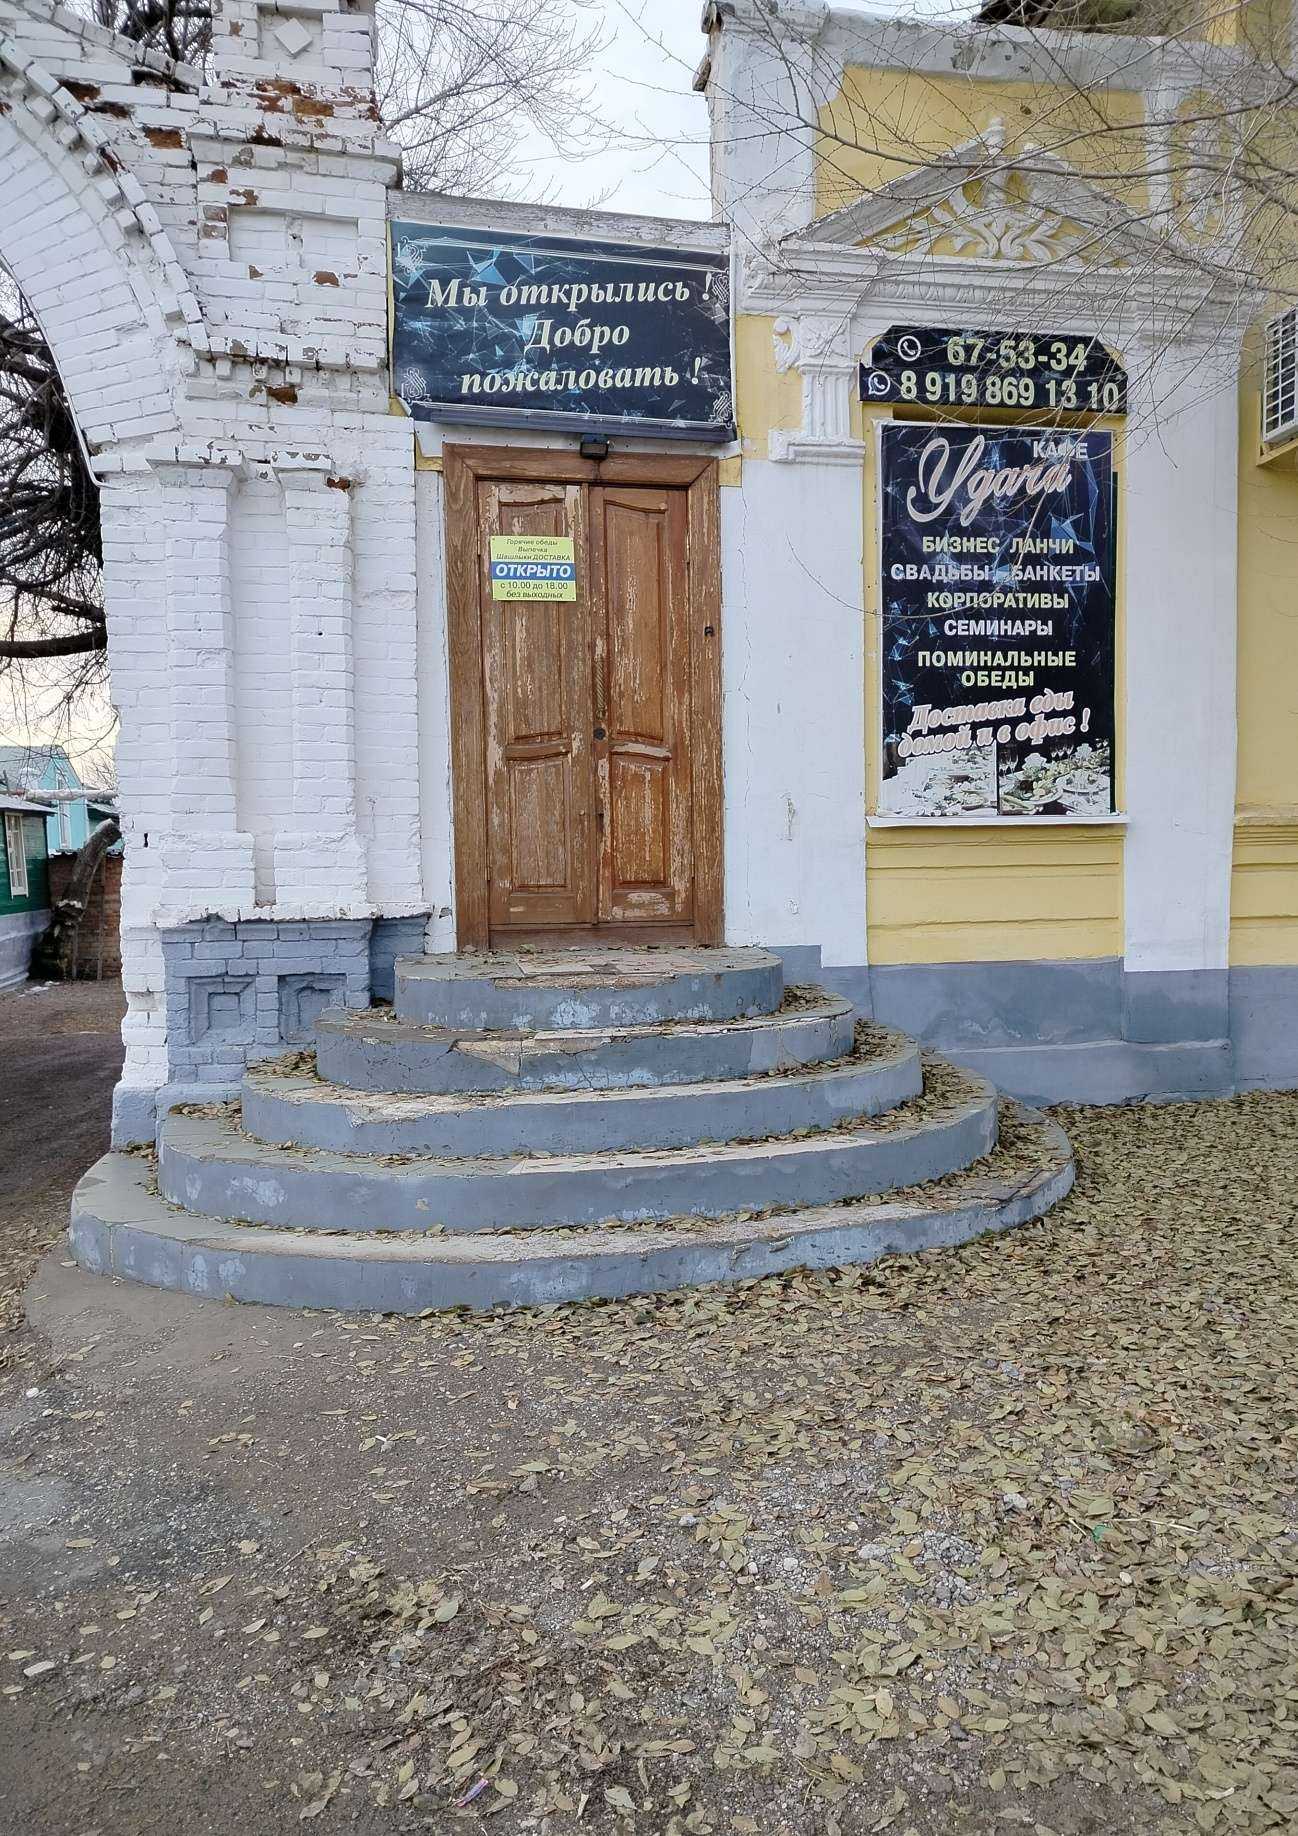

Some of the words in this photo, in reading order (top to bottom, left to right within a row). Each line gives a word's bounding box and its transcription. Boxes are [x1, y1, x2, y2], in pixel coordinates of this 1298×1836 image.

[424, 278, 488, 308] Мы
[499, 280, 690, 313] открылись
[523, 318, 630, 354] Добро
[947, 336, 1088, 372] 67-53-34
[461, 366, 679, 394] пожаловать
[900, 370, 917, 400] 8
[925, 371, 977, 403] 919
[985, 375, 1035, 406] 869
[1044, 379, 1077, 409] 13
[1088, 382, 1119, 410] 10
[1032, 440, 1088, 460] КАФЕ
[922, 536, 1000, 553] БИЗНЕС
[1009, 537, 1074, 554] ЛАНЧИ
[495, 563, 571, 578] ОТКРЫТО
[1011, 565, 1100, 581] БАНКЕТЫ
[506, 590, 521, 598] без
[522, 591, 564, 599] выходных
[508, 581, 531, 589] 10.00
[532, 582, 543, 590] до
[545, 582, 568, 590] 18.00
[927, 591, 1069, 609] КОРПОРАТИВЫ
[944, 619, 1053, 637] СЕМИНАРЫ
[917, 650, 1077, 667] ПОМИНАЛЬНЫЕ
[961, 670, 1034, 689] ОБЕДЫ
[906, 697, 1026, 735] Доставка
[1029, 687, 1075, 714] еды
[897, 725, 973, 758] домой
[976, 726, 995, 747] и
[996, 724, 1012, 743] в
[1014, 713, 1077, 745] офис
